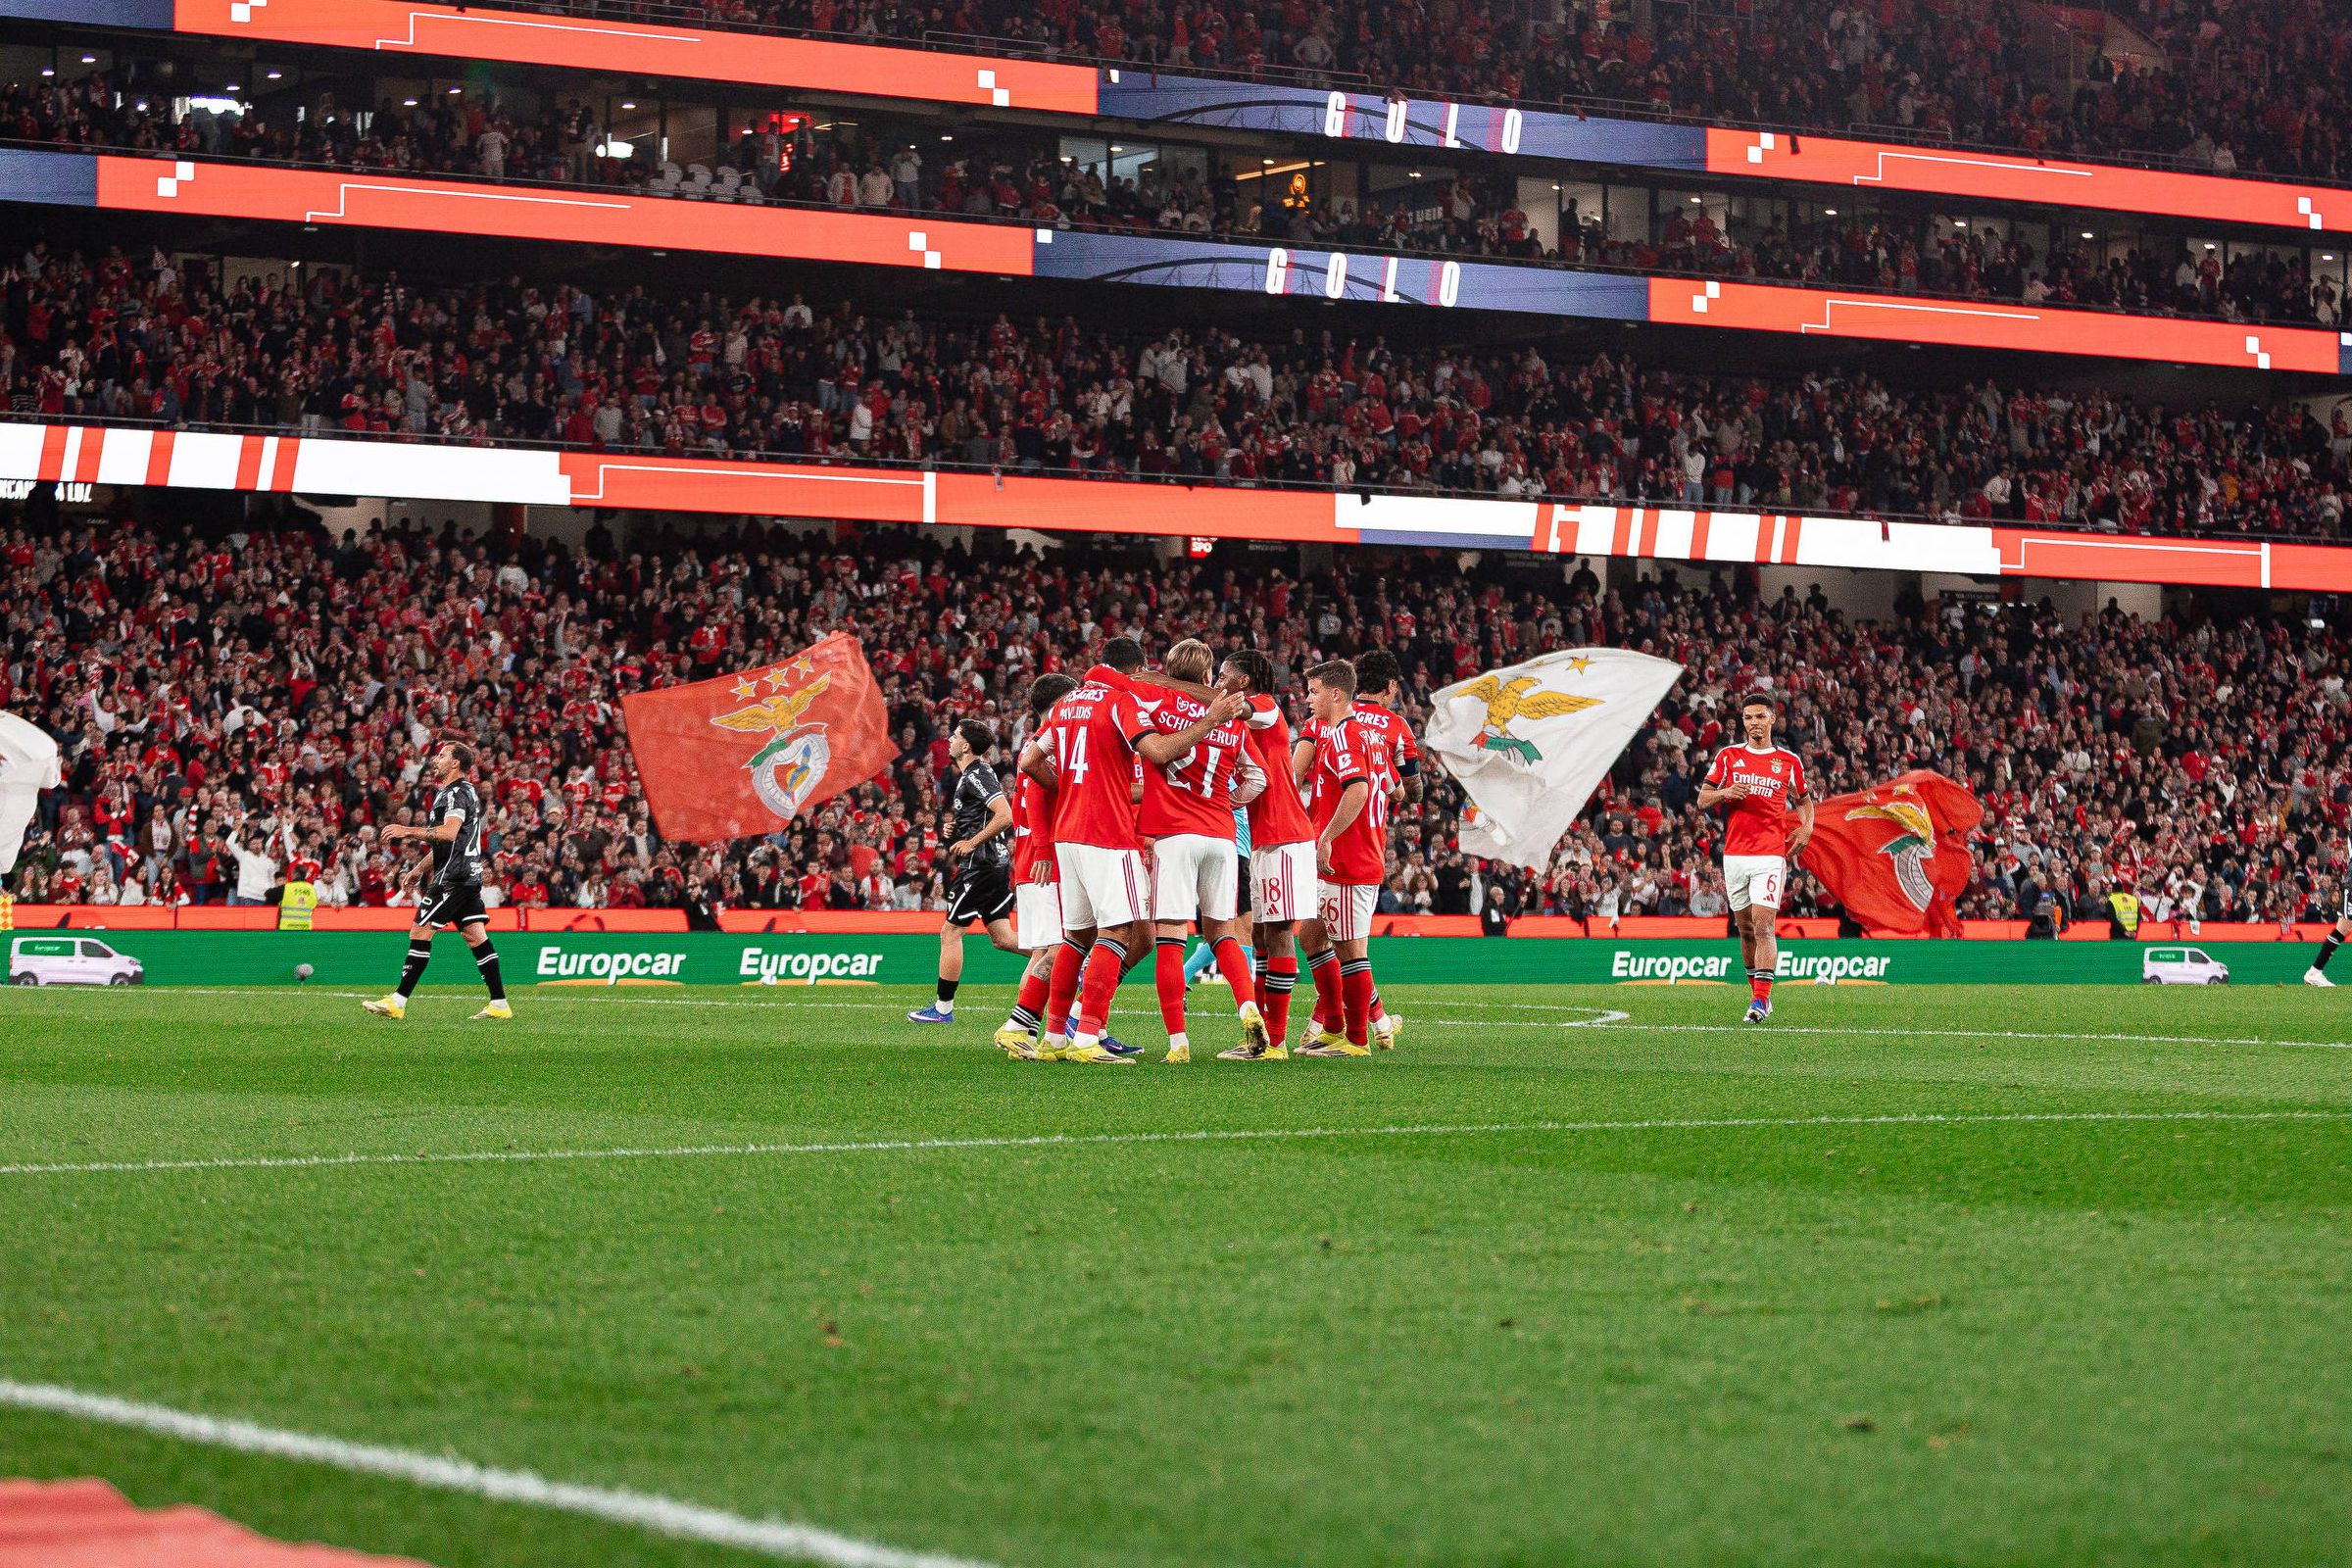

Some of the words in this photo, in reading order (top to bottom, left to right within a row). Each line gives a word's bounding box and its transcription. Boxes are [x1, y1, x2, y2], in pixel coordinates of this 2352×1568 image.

[1265, 247, 1461, 308] GOLO
[1353, 710, 1390, 729] GRES
[1056, 726, 1089, 784] 14
[1167, 745, 1221, 799] 21
[1733, 771, 1783, 791] Emirates
[1749, 785, 1775, 799] BETTER
[1261, 877, 1281, 904] 18
[1766, 874, 1778, 893] 6
[537, 947, 687, 985] Europcar
[739, 948, 884, 985] Europcar
[1612, 951, 1732, 985] Europcar
[1775, 951, 1890, 985] Europcar
